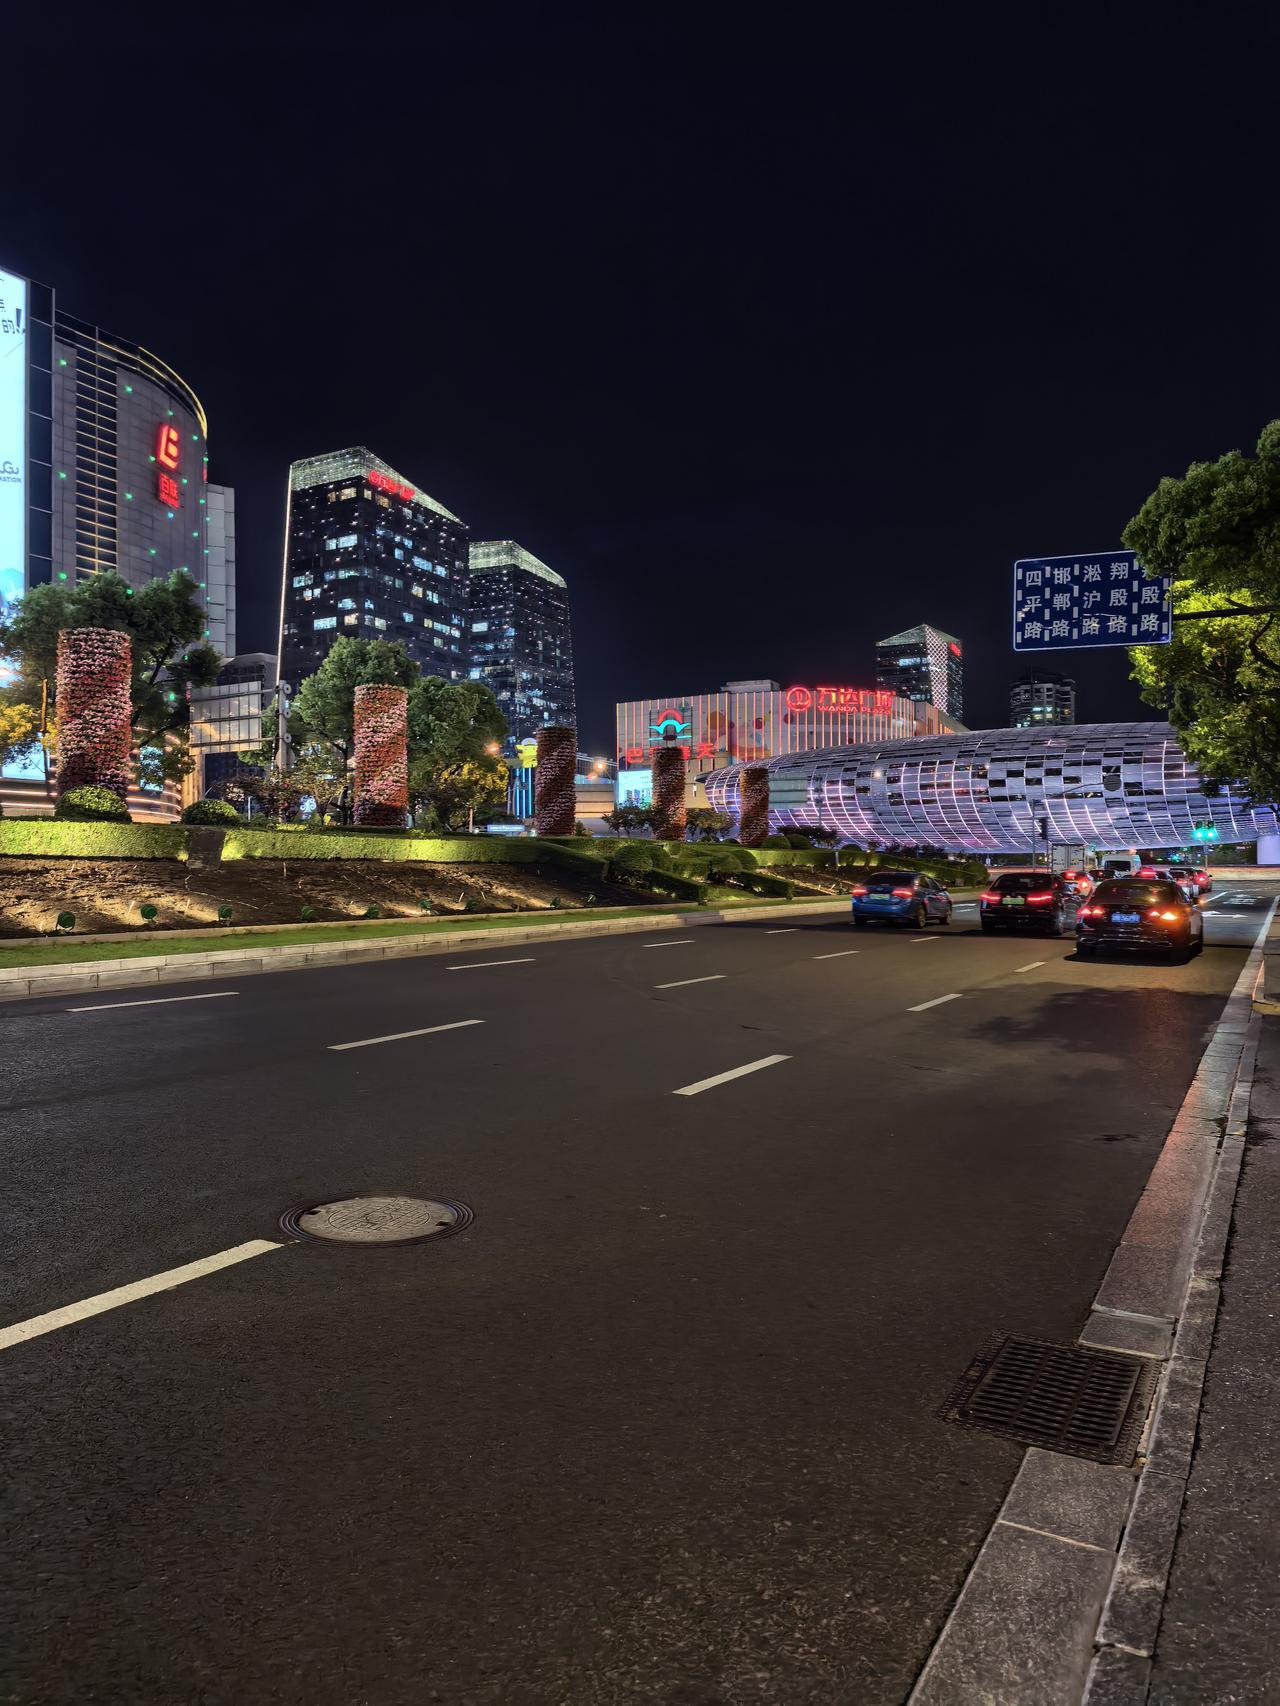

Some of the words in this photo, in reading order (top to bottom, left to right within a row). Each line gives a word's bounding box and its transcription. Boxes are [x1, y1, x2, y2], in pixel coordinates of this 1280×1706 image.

[1024, 570, 1043, 639] 四平路
[1051, 567, 1071, 638] 邯郸路
[1081, 563, 1102, 636] 淞沪路
[1107, 561, 1129, 634] 翔殷路
[1139, 567, 1161, 632] 殷路
[816, 687, 893, 708] 万达广场
